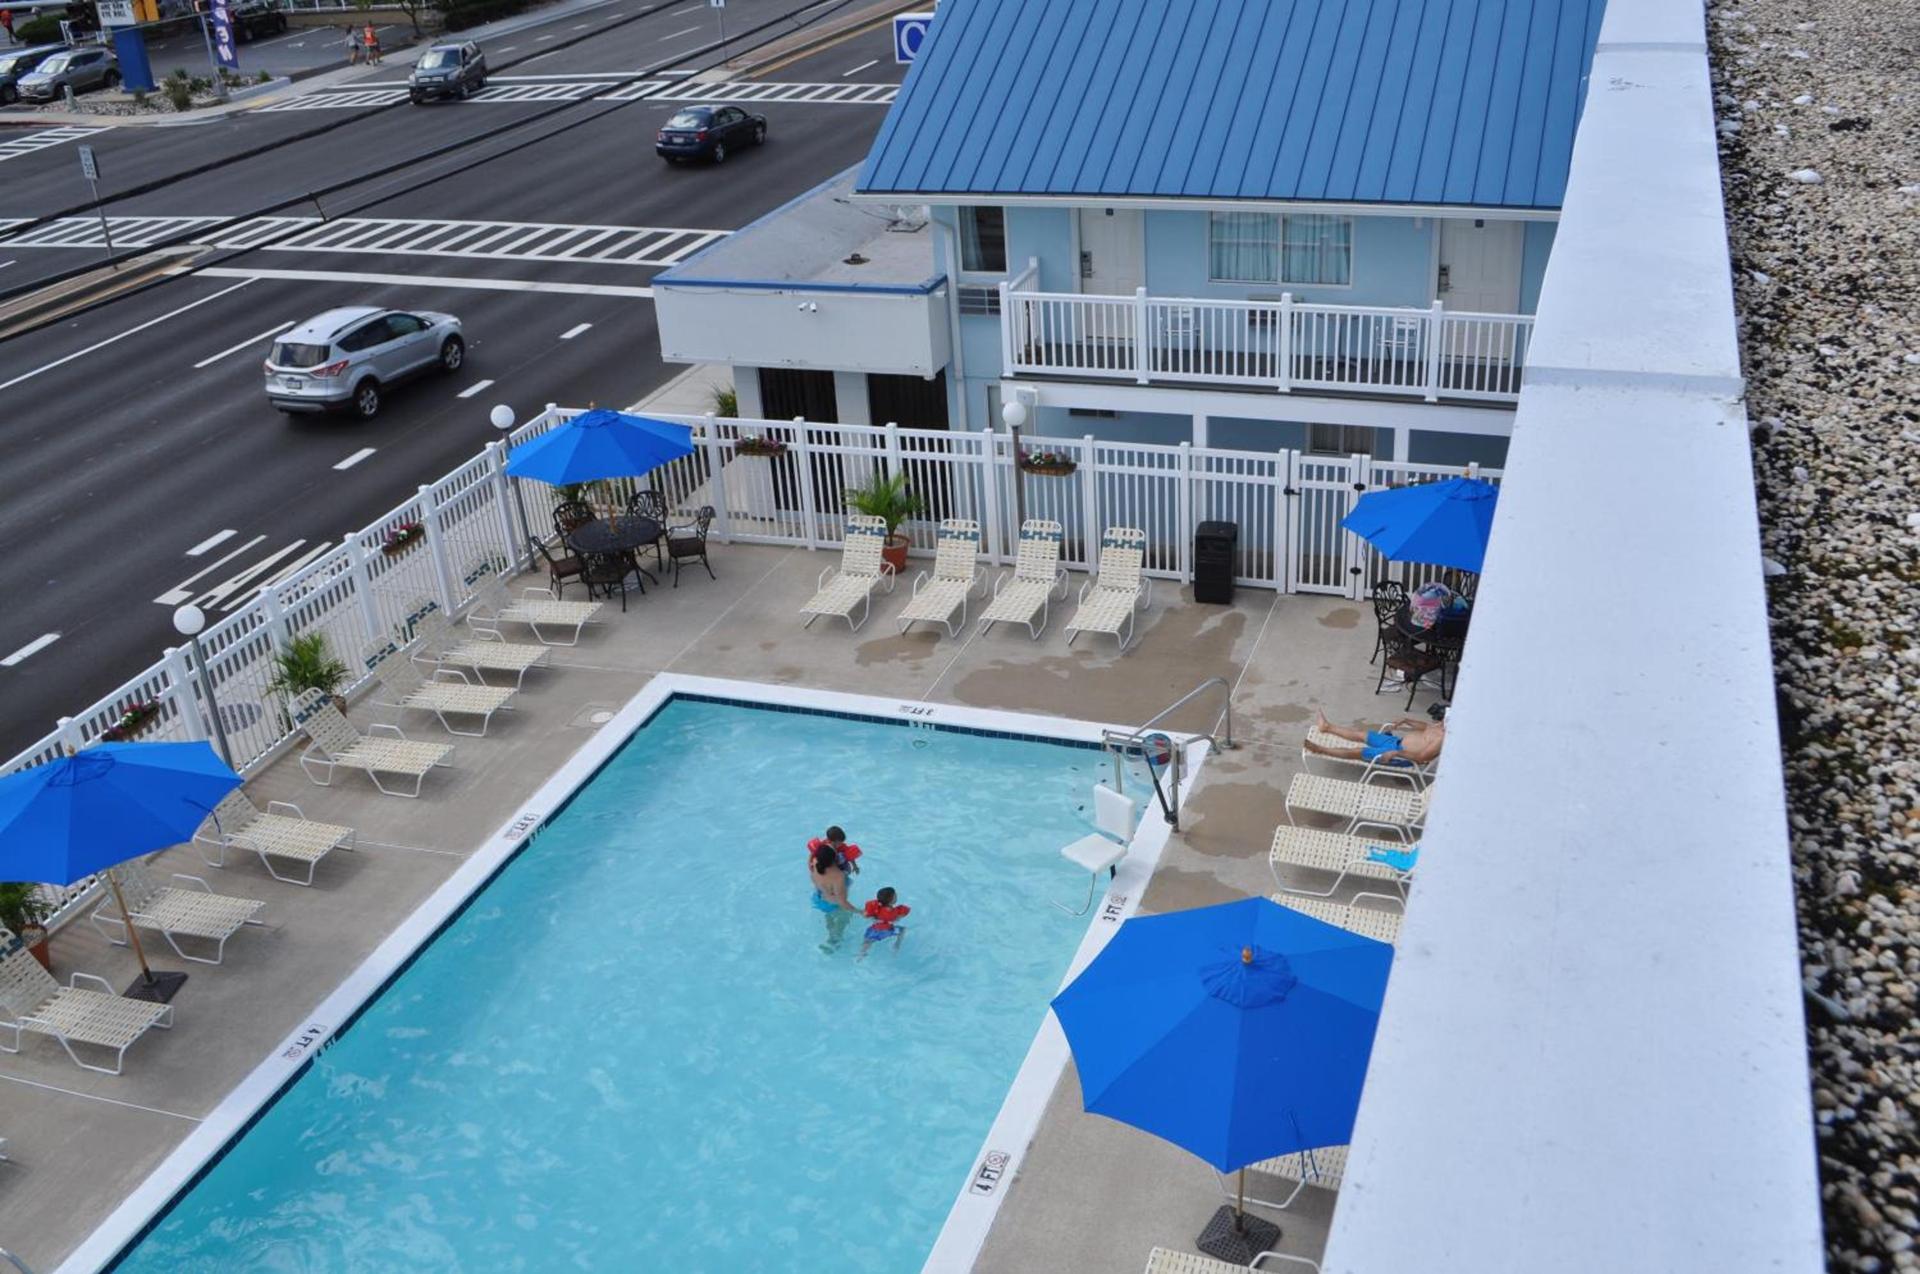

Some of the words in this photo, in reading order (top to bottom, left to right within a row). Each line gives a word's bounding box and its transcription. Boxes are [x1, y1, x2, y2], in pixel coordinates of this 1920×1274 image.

[1106, 904, 1122, 915] FT
[295, 1035, 313, 1048] FT
[980, 1166, 1000, 1181] FT
[975, 1183, 993, 1191] 4
